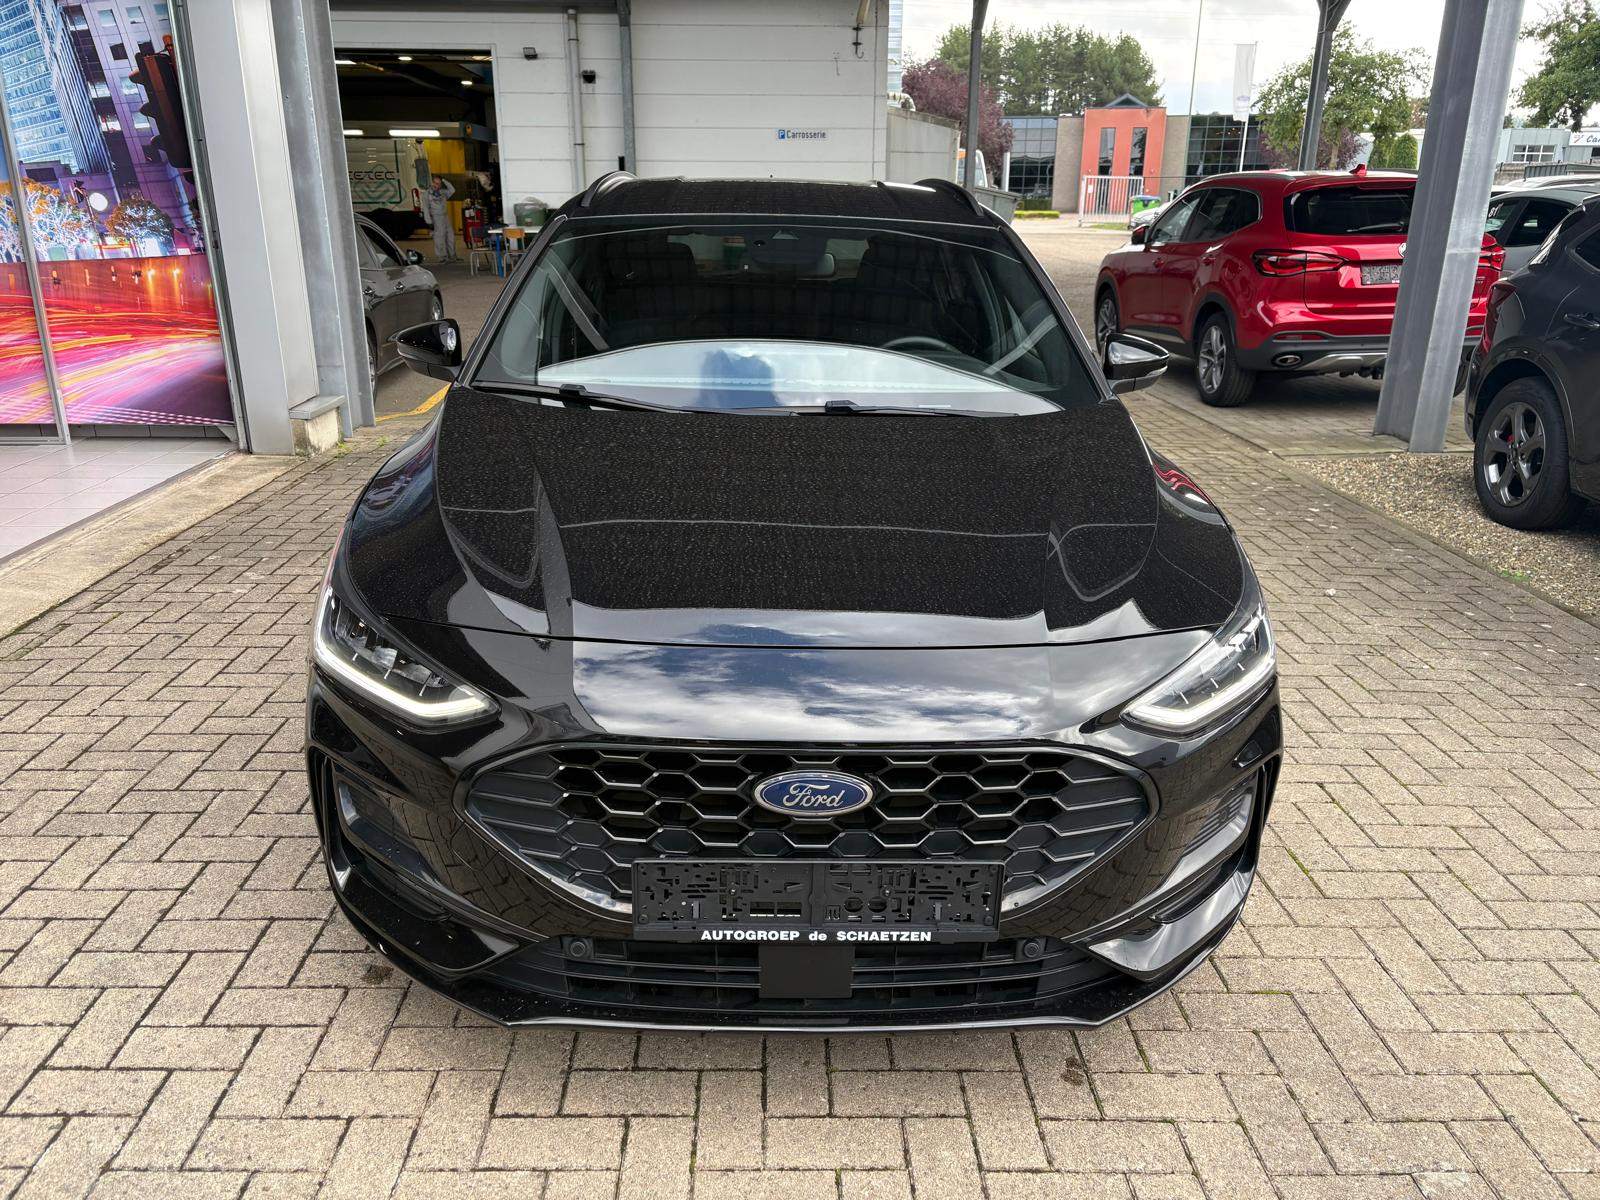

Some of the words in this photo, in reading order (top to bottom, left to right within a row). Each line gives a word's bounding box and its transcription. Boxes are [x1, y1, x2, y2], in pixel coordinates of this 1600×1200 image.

[786, 130, 827, 139] Carrosserie
[1586, 135, 1600, 143] Ca
[782, 782, 845, 807] Ford
[700, 930, 800, 941] AUTOGROEP
[808, 930, 828, 941] de
[836, 930, 932, 942] SCHAETZEN
